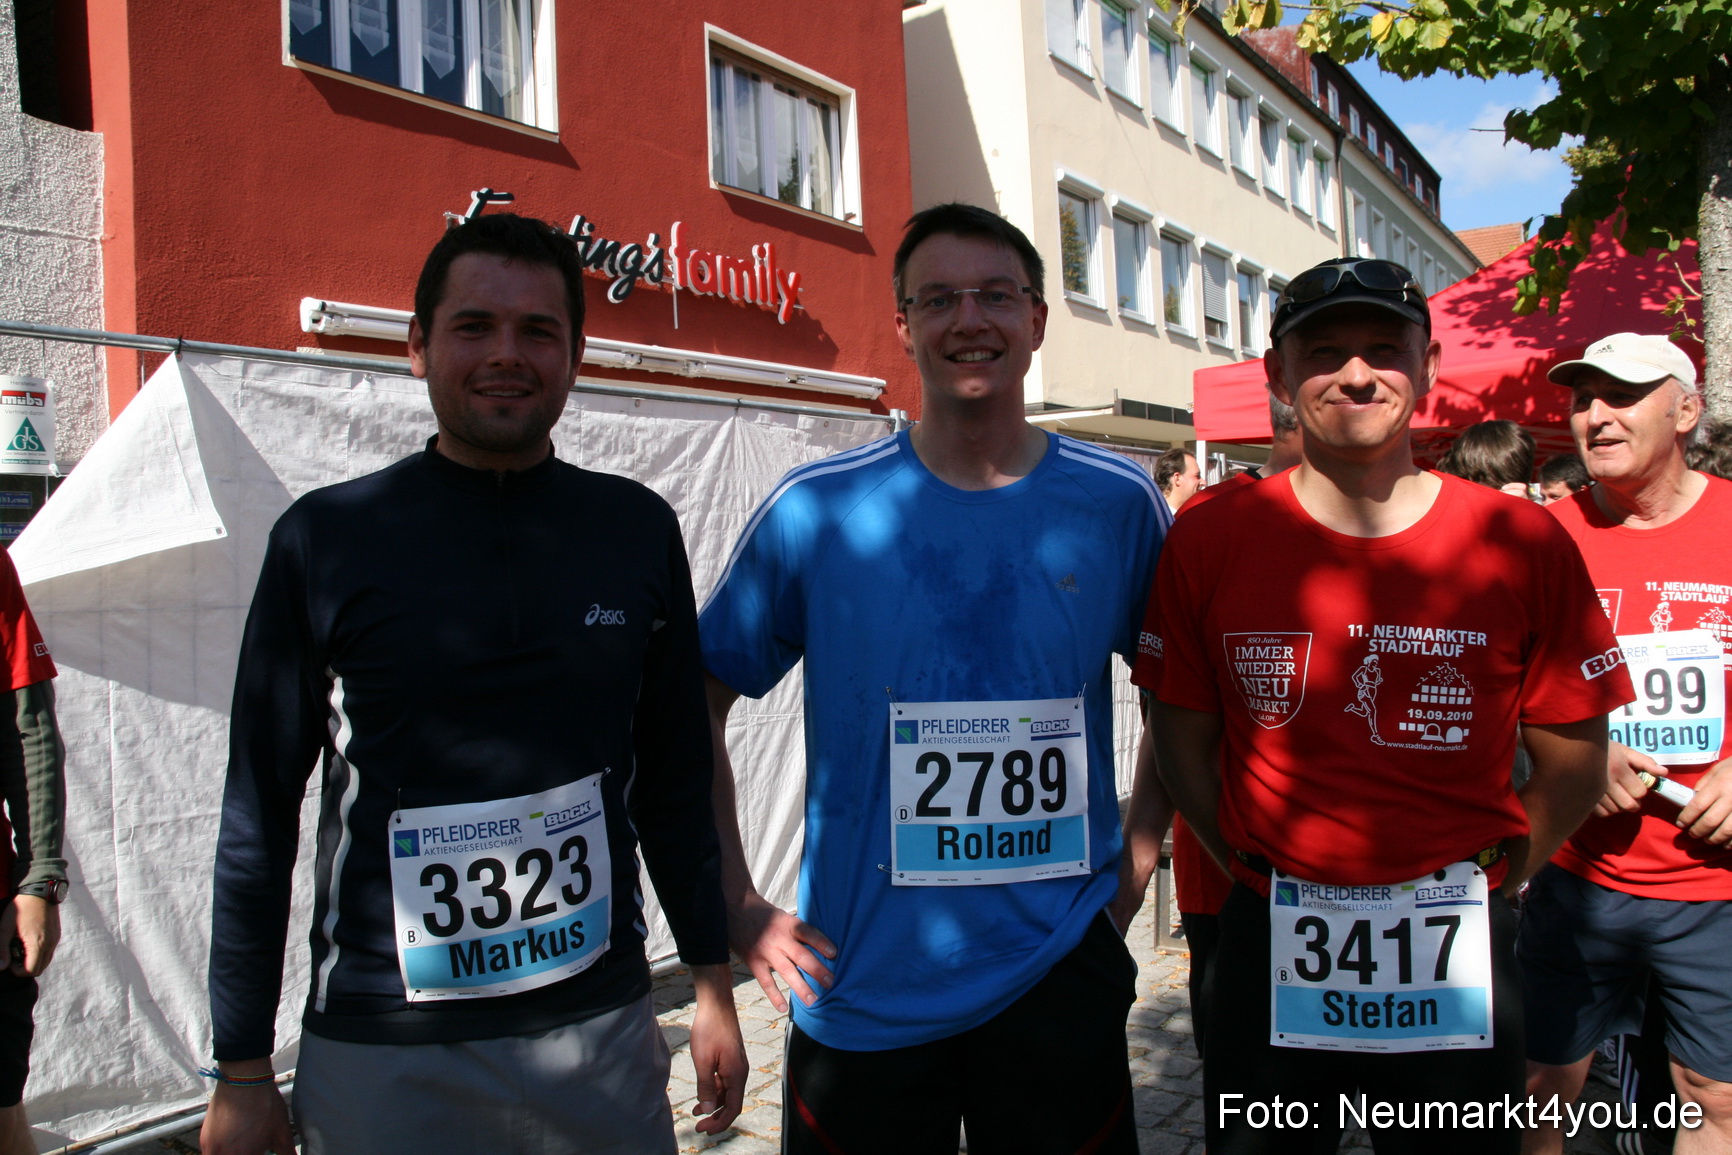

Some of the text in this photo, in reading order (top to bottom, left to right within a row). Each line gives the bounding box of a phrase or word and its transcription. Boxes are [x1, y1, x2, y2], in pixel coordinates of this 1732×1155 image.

[669, 220, 802, 324] family
[2, 391, 44, 407] müba
[1645, 581, 1661, 592] 11.
[1660, 591, 1730, 605] STADTLAUF
[1348, 624, 1487, 646] 11. NEUMARKTER
[1235, 646, 1294, 659] IMMER
[1368, 639, 1464, 658] STADTLAUF
[1234, 661, 1296, 675] WIEDER
[1240, 677, 1291, 698] NEU
[1248, 696, 1290, 714] MARKT
[1407, 708, 1473, 721] 19.09.2010
[922, 717, 1011, 734] PFLEIDERER
[1030, 718, 1070, 734] BOCK
[922, 735, 1011, 745] AKTIENGESELLSCHAFT
[1609, 722, 1709, 753] olfgang
[1387, 741, 1468, 752] www.stadtlauf-neumarkt.de
[915, 747, 1067, 818] 2789
[544, 801, 592, 828] BOCK
[900, 809, 908, 820] D
[422, 818, 522, 845] PFLEIDERER
[424, 836, 524, 856] AKTIENGESELLSCHAFT
[937, 820, 1052, 861] Roland
[420, 835, 592, 938] 3323
[1301, 884, 1392, 901] PFLEIDERER
[1415, 885, 1467, 901] BOCK
[1302, 902, 1393, 912] AKTIENGESELLSCHAFT
[407, 930, 416, 943] B
[449, 920, 585, 979] Markus
[1294, 915, 1461, 985] 3417
[1280, 970, 1288, 982] B
[1323, 990, 1438, 1028] Stefan
